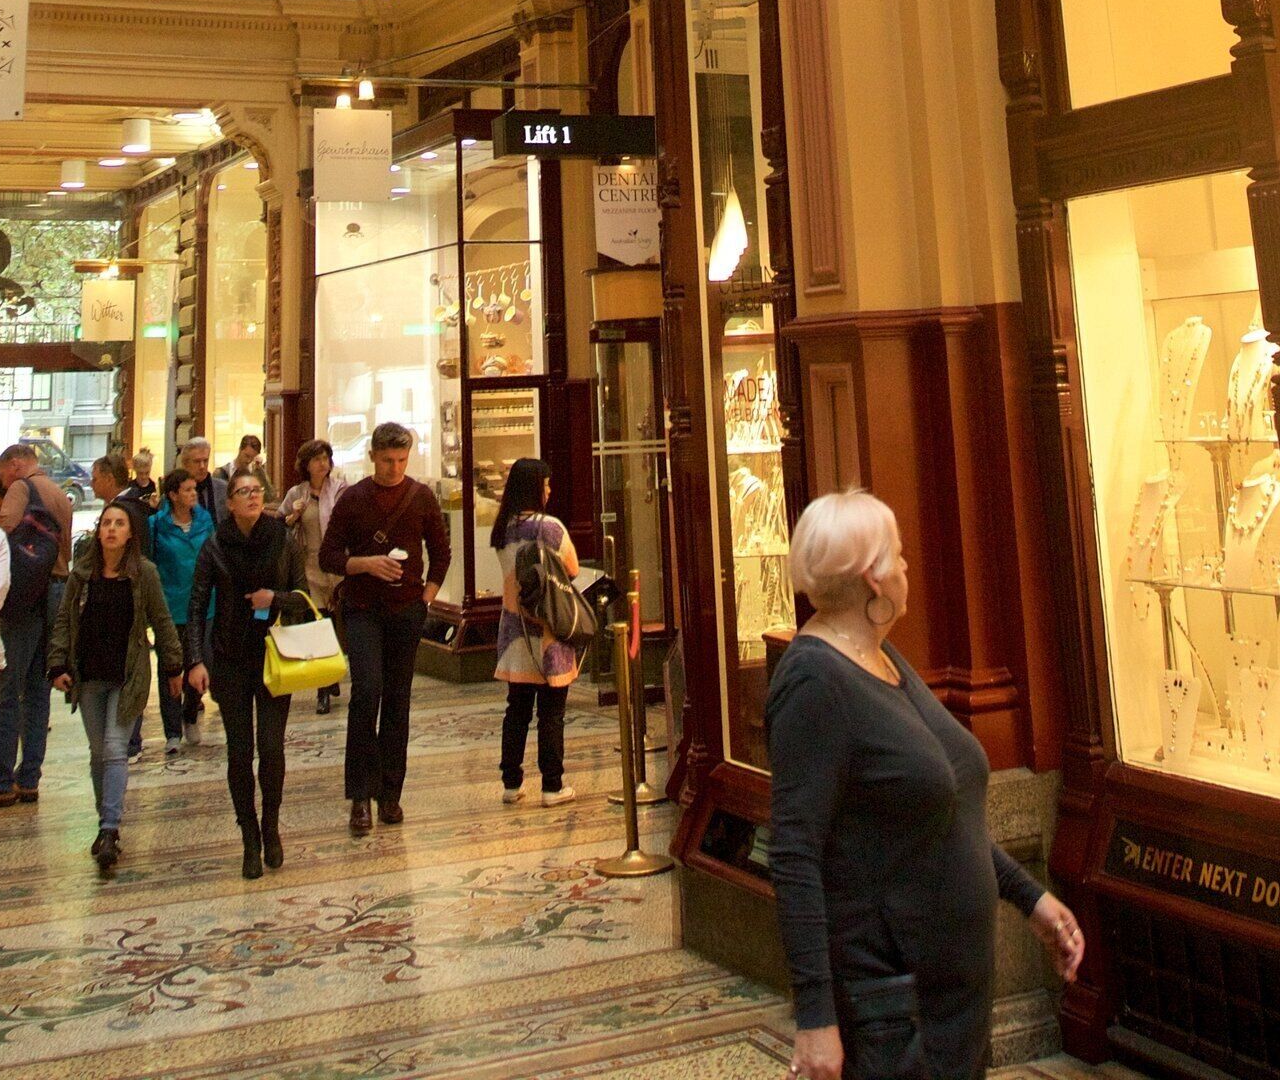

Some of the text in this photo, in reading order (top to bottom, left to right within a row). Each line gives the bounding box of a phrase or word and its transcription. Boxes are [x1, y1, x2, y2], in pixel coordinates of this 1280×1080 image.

[523, 125, 571, 144] Lift 1
[598, 172, 657, 186] DENTAL
[598, 188, 657, 202] CENTRE
[1142, 846, 1193, 883] ENTER
[1198, 862, 1248, 897] NEXT
